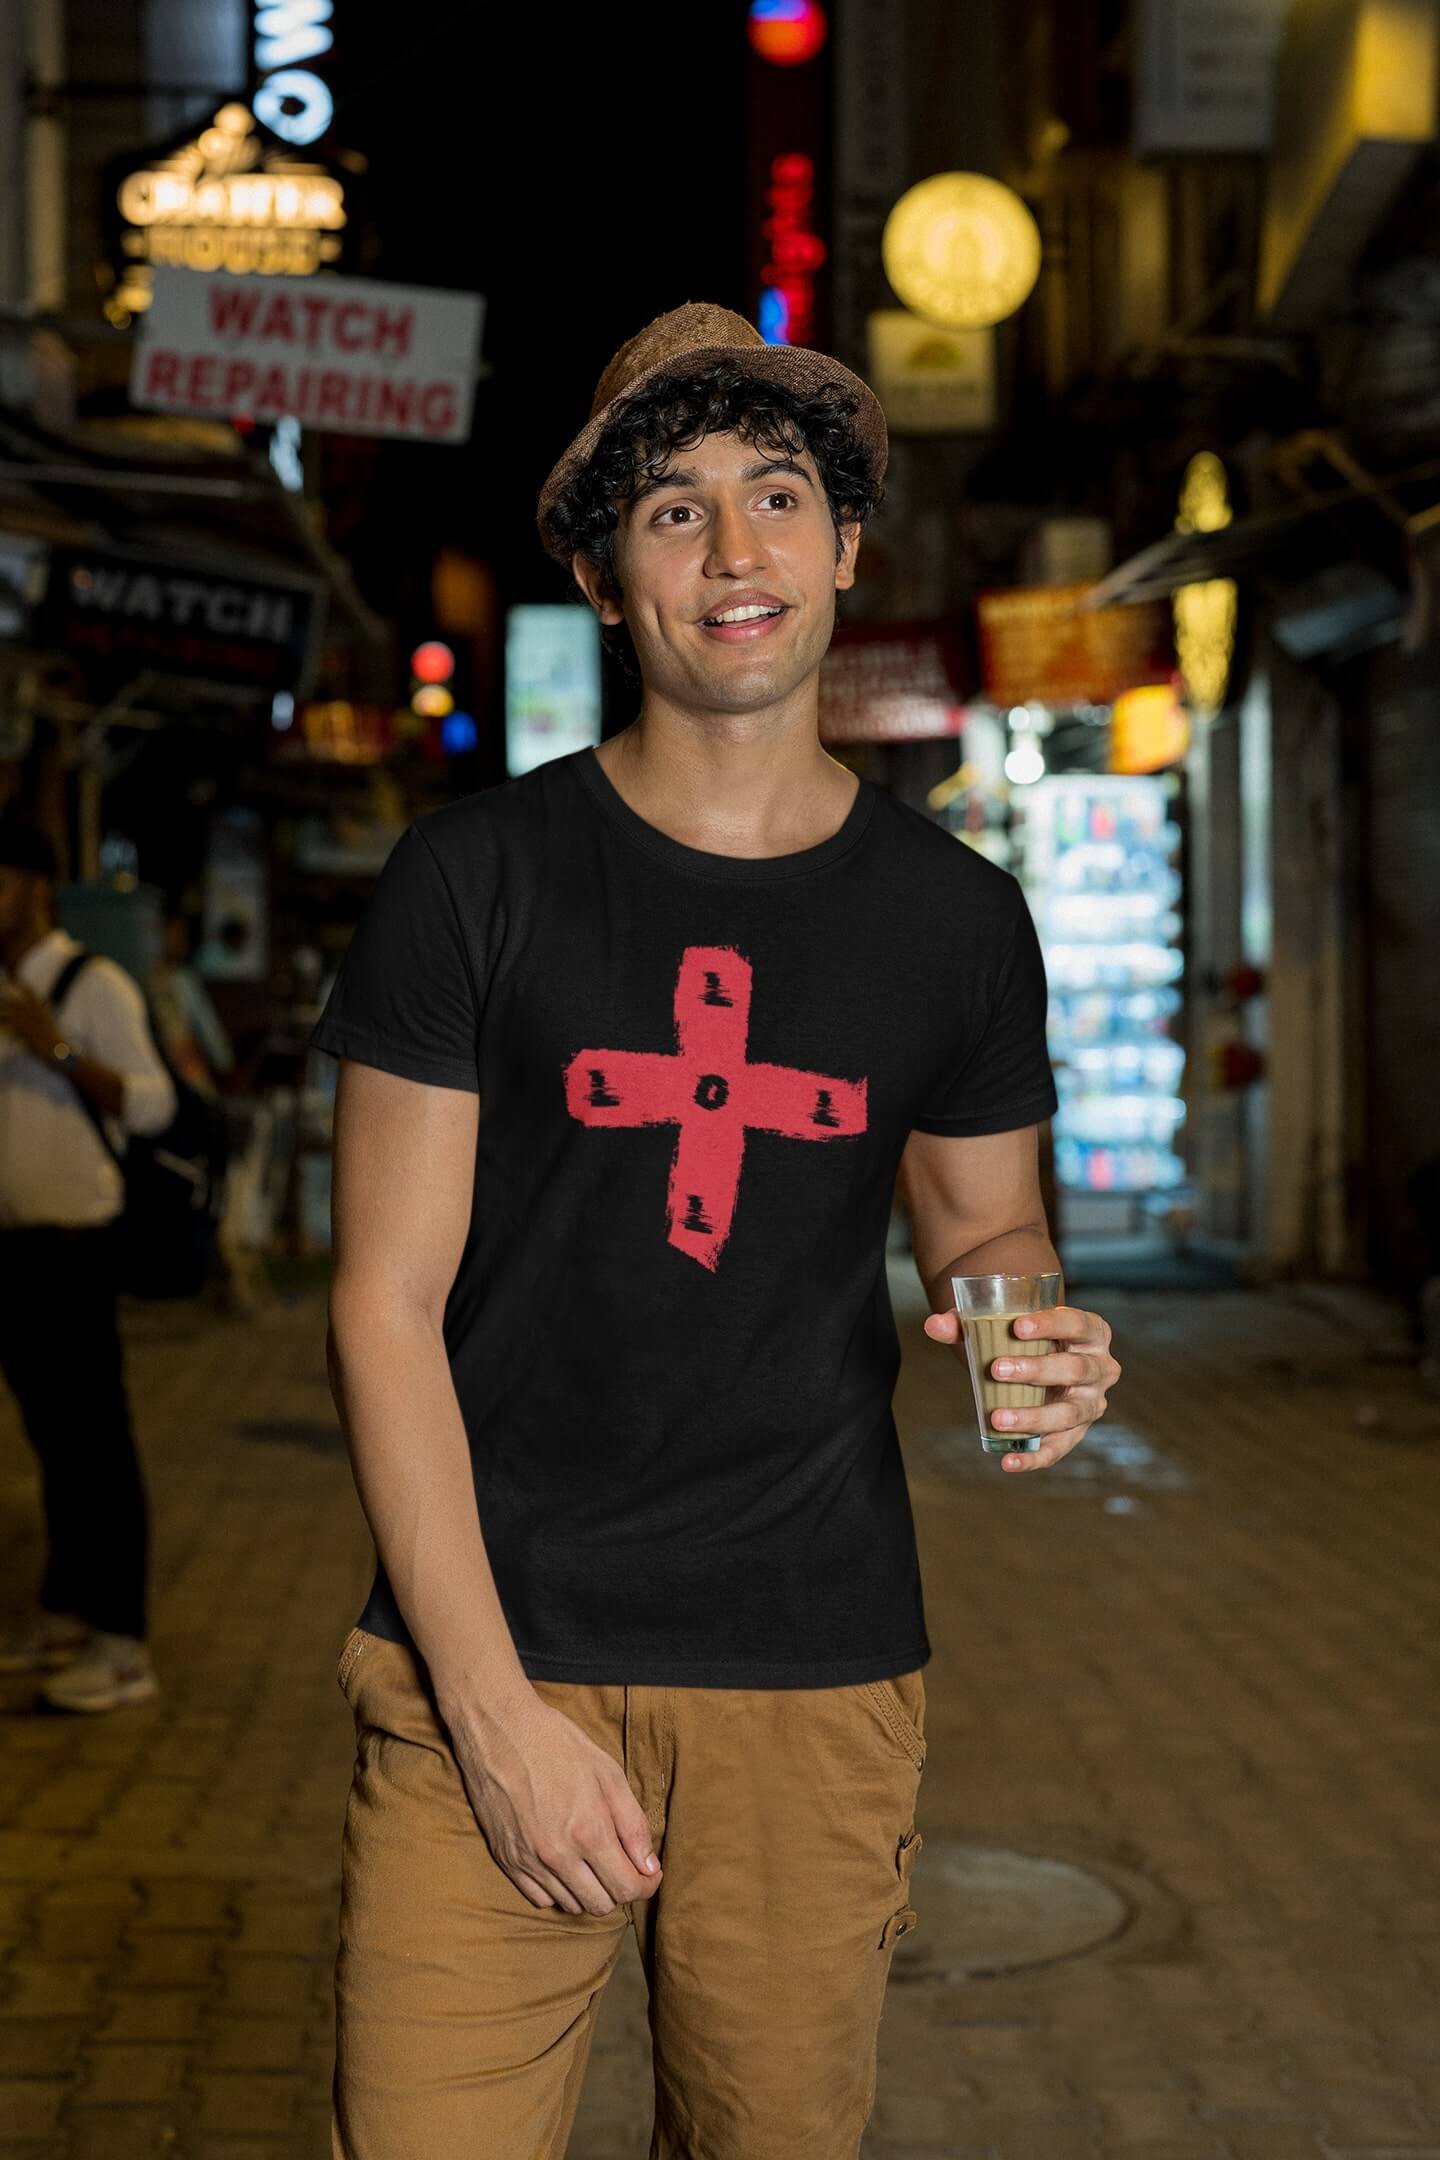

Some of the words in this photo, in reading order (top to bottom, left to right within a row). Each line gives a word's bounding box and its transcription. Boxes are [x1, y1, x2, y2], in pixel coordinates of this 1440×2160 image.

[207, 283, 416, 359] WATCH
[144, 350, 460, 435] REPAIRING
[68, 566, 296, 644] WATCH
